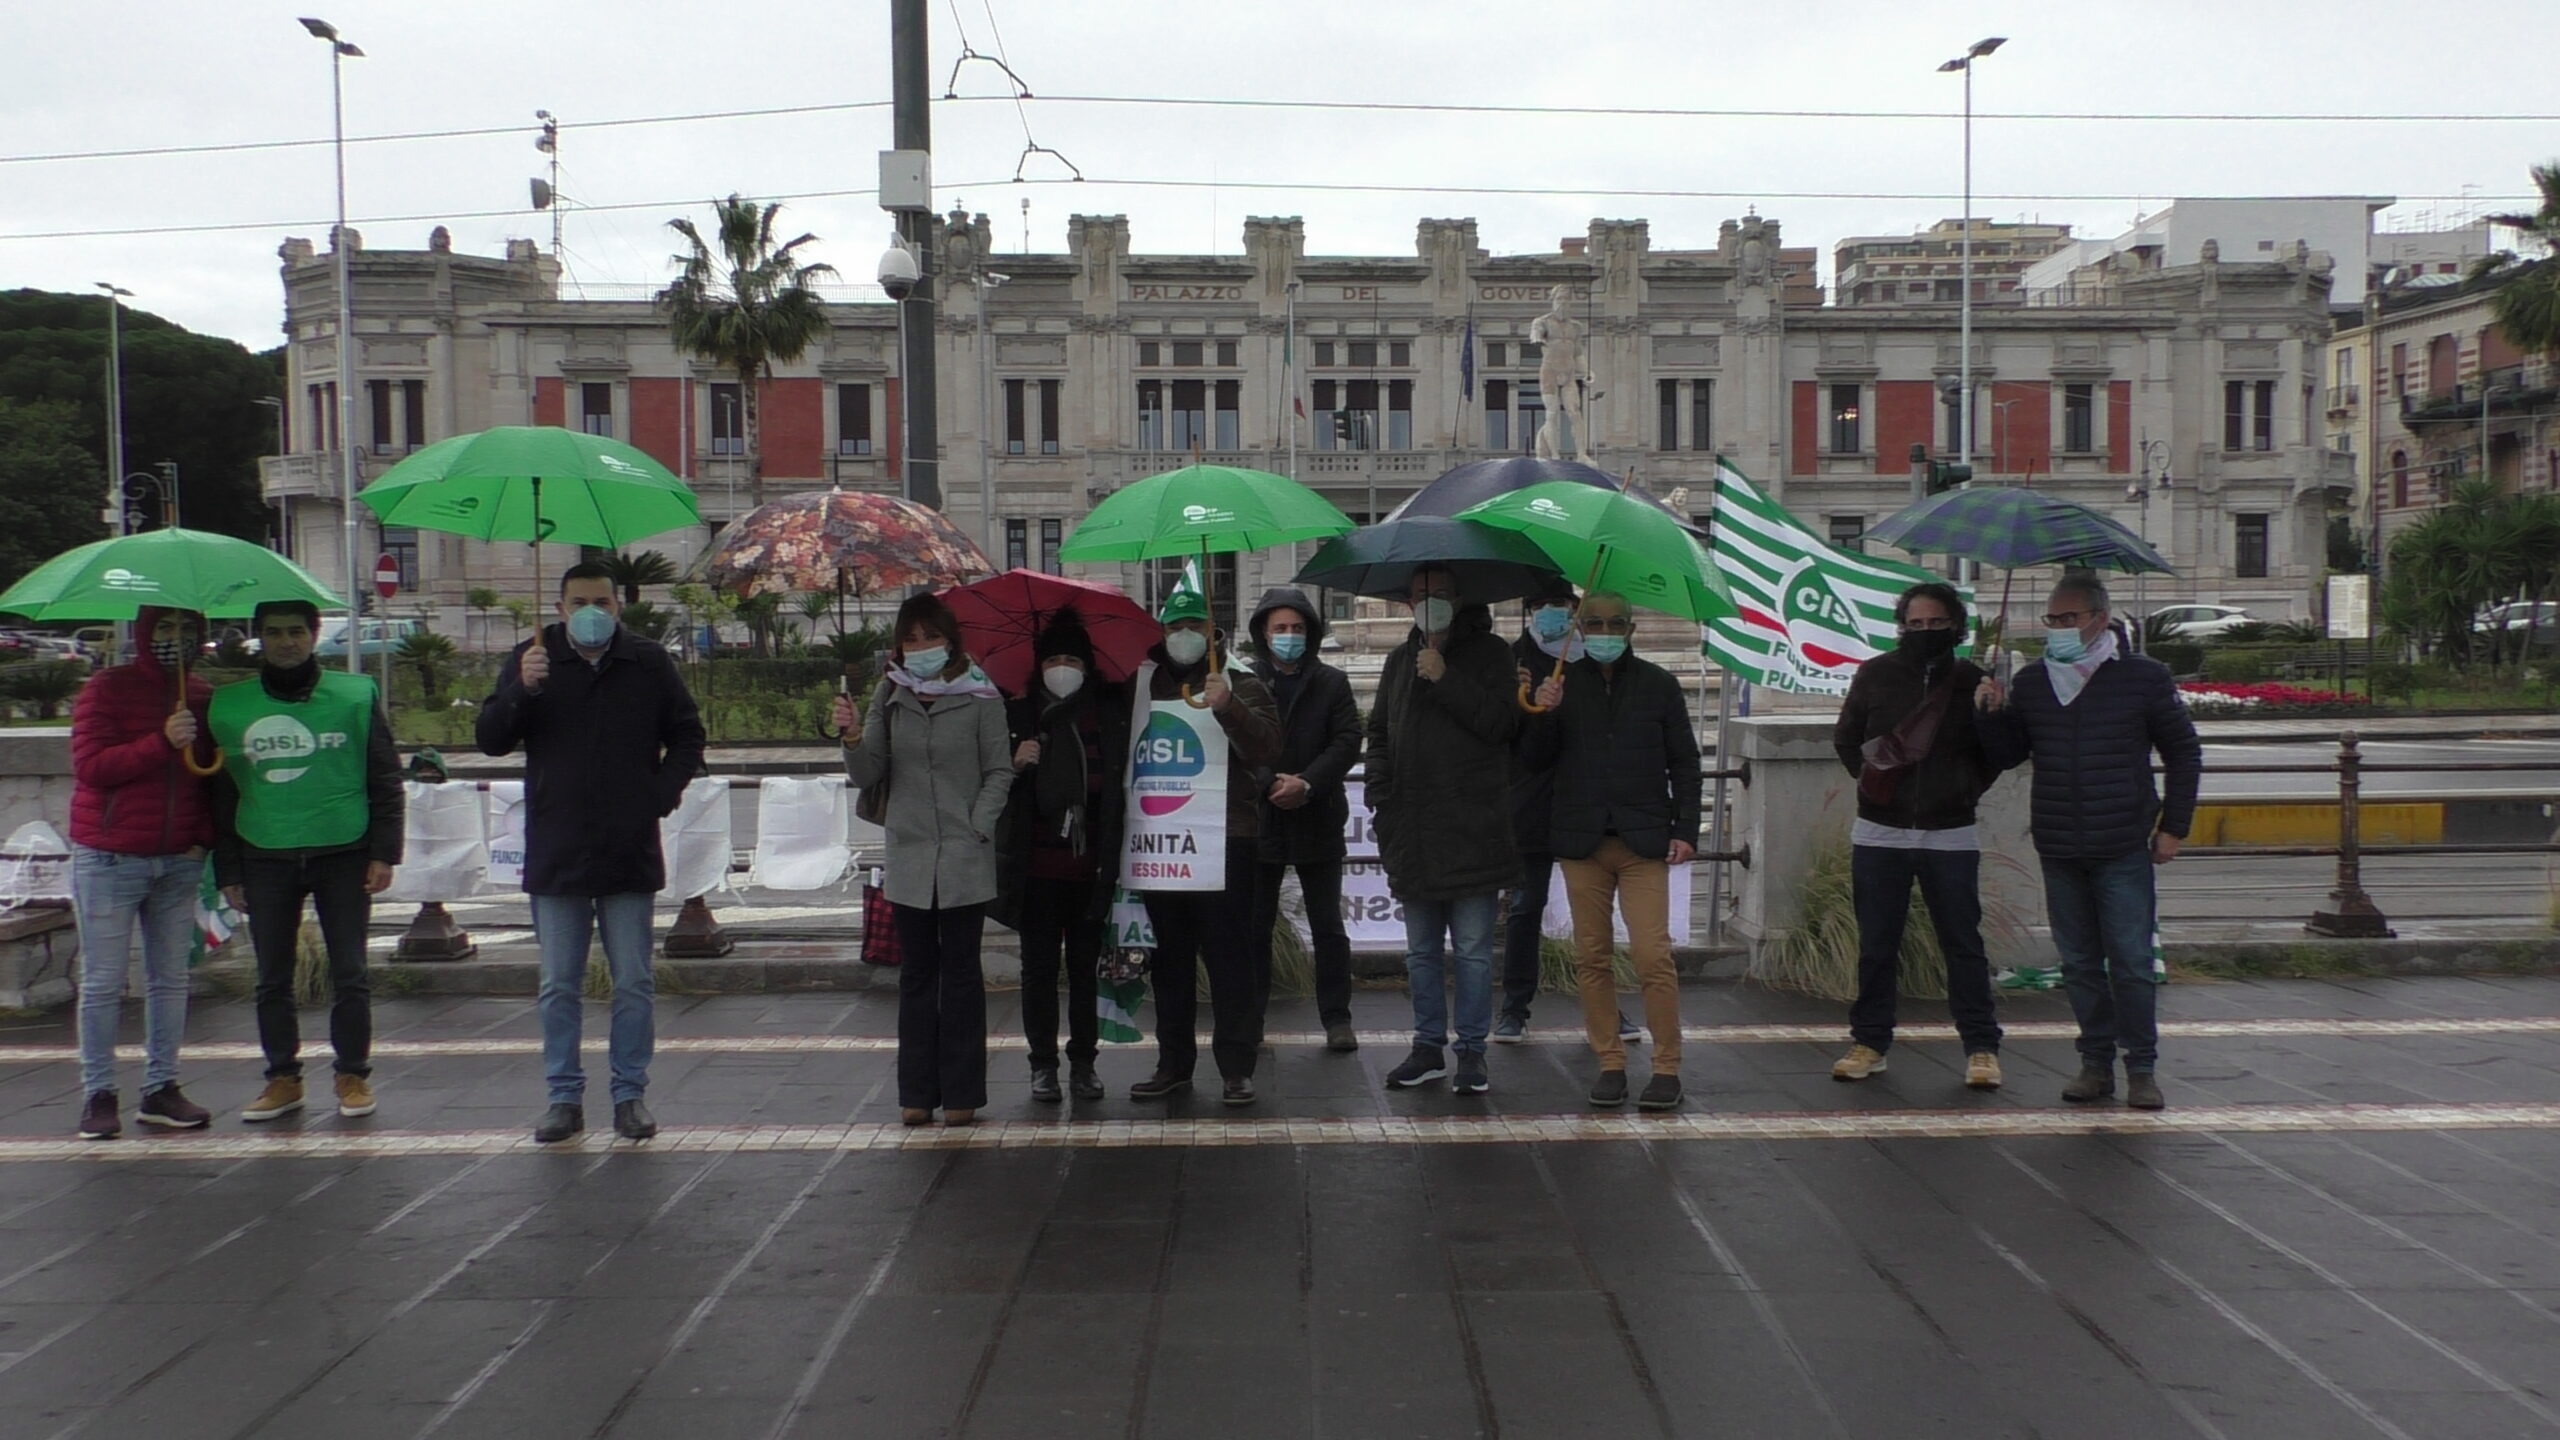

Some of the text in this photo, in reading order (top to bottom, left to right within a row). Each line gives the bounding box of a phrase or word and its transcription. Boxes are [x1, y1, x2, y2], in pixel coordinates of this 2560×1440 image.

[1132, 286, 1588, 300] PALAZZO DEL GOVERO
[1772, 640, 1854, 681] FUNZIO
[252, 732, 347, 752] CISL FP
[1135, 737, 1195, 764] CISL
[1130, 829, 1197, 854] SANITÀ
